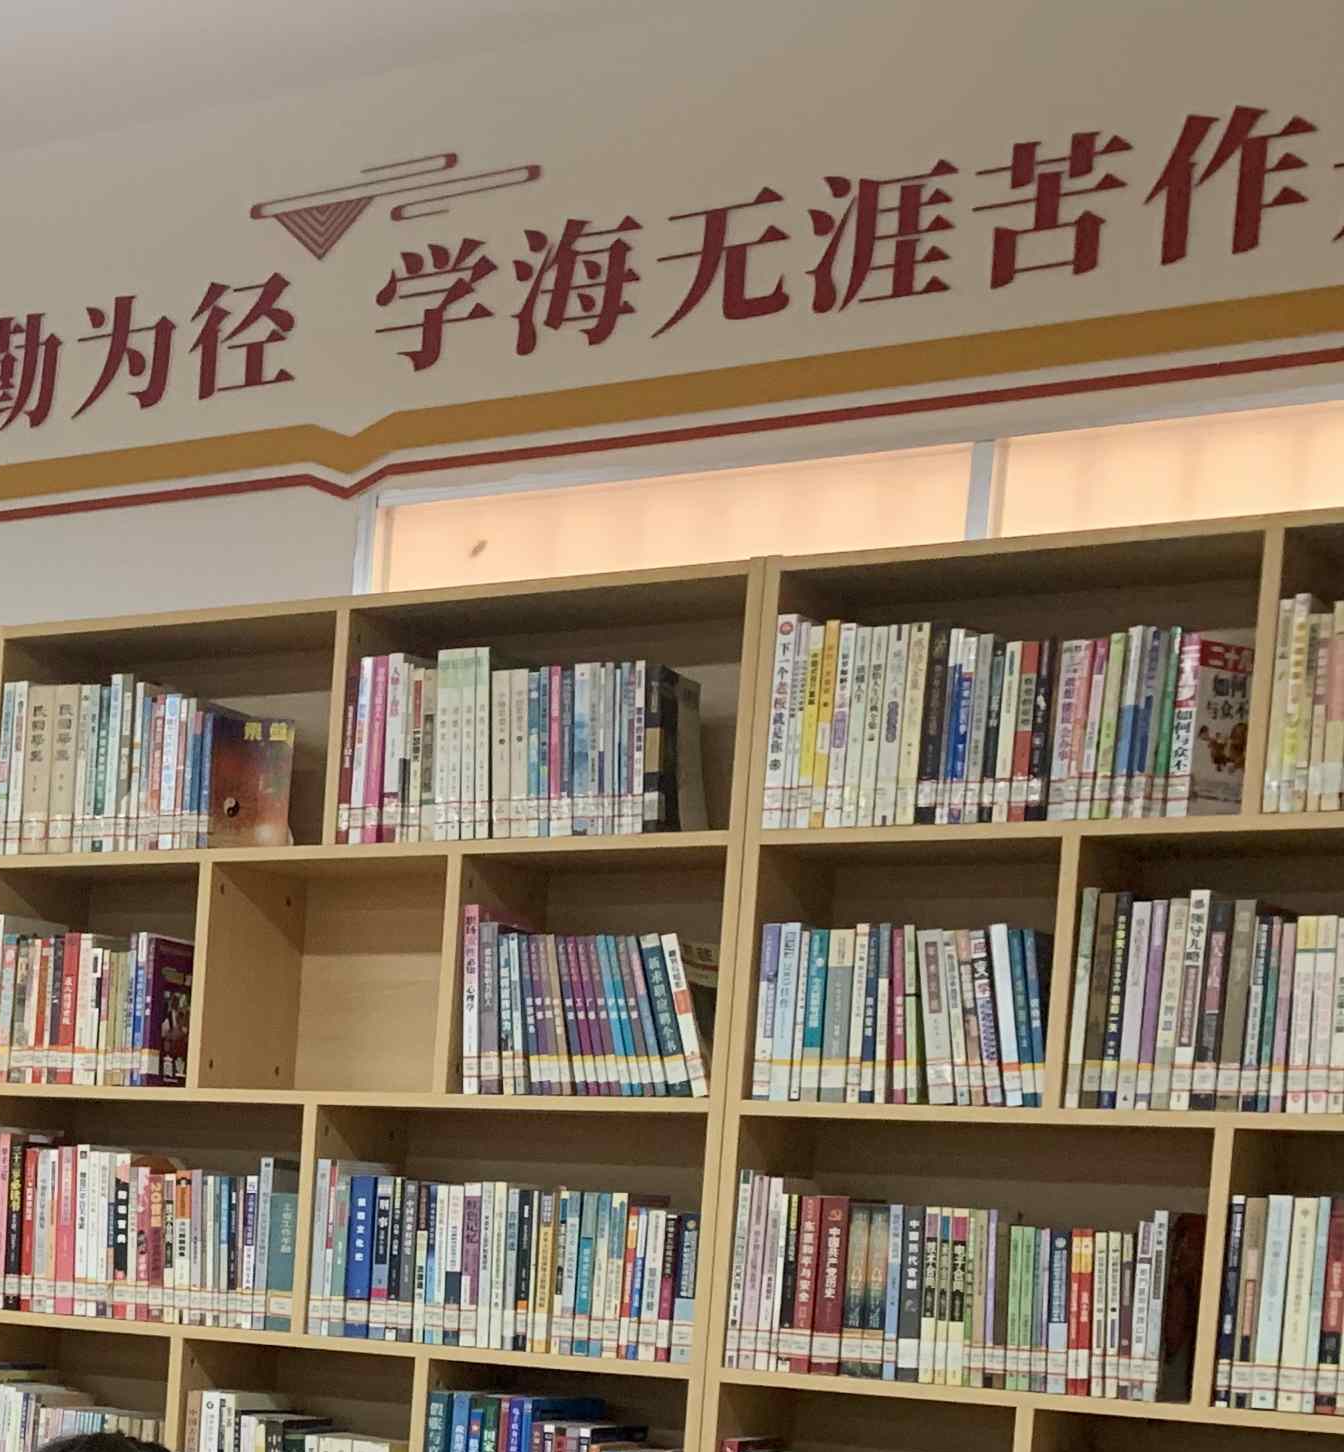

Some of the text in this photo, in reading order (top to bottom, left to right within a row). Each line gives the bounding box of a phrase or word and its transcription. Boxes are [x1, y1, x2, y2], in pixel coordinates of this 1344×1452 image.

[375, 104, 1344, 371] 学海无涯苦作
